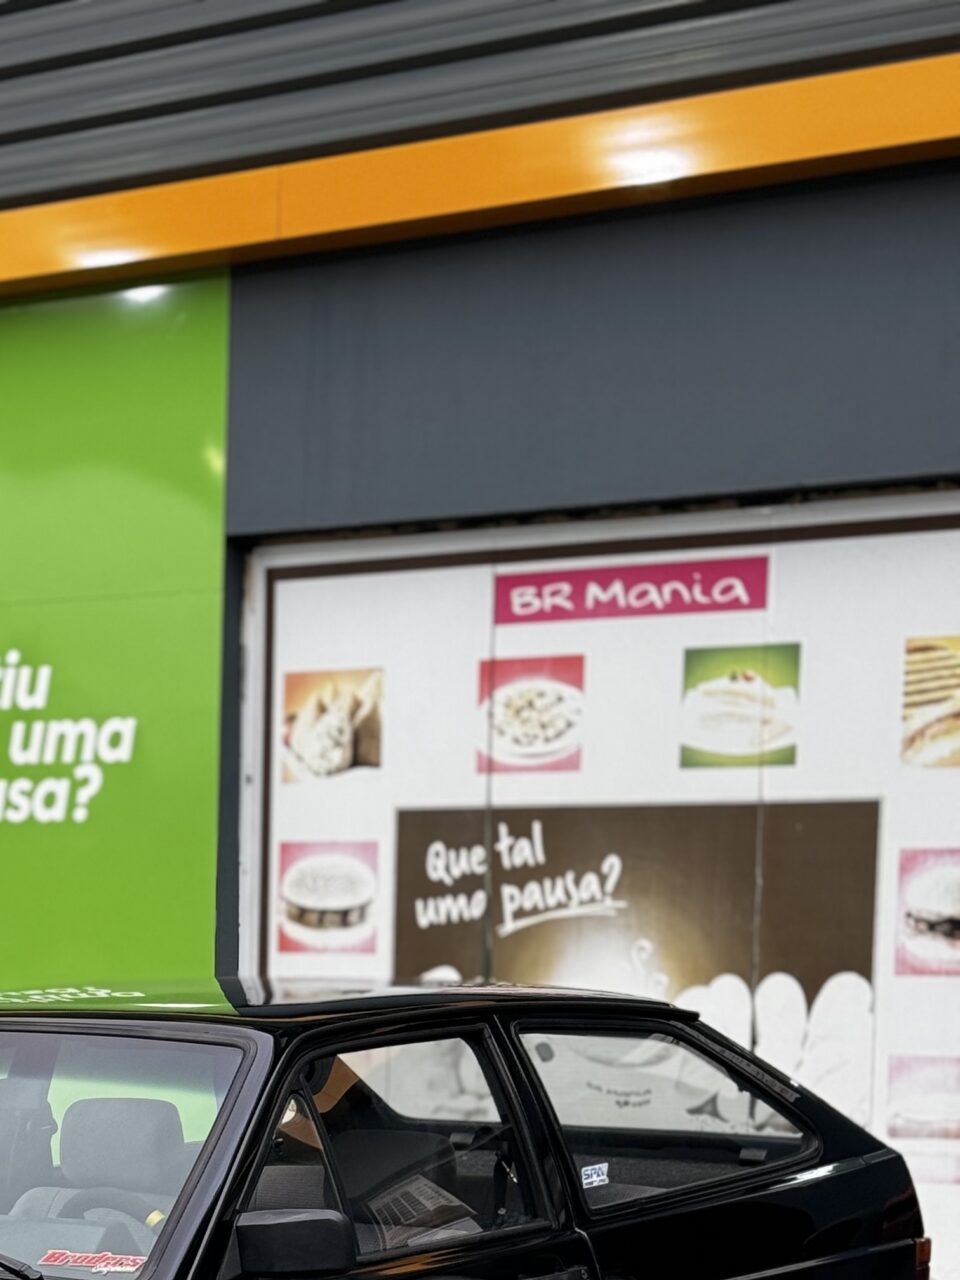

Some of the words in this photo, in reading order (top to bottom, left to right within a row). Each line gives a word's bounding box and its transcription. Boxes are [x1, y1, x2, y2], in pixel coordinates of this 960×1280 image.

[510, 582, 574, 616] BR
[585, 572, 750, 610] Mania
[9, 716, 137, 766] uma
[426, 841, 488, 886] Que
[494, 820, 546, 870] tal
[499, 853, 623, 932] pausa?
